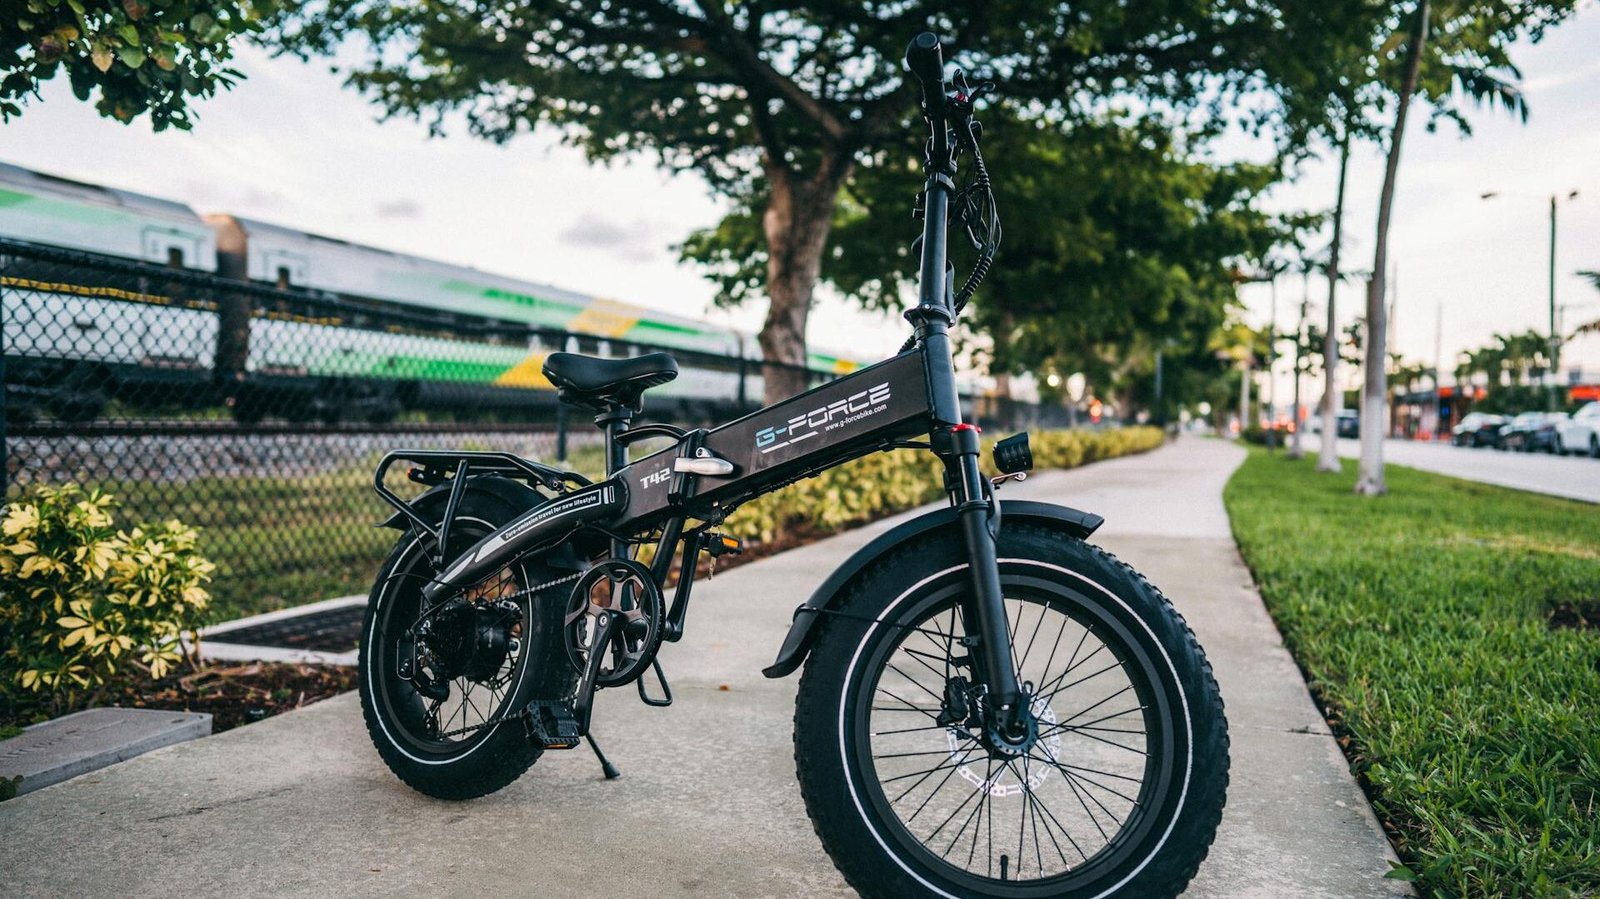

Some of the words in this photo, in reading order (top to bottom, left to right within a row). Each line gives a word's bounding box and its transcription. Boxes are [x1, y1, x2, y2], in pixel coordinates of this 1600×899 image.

[755, 382, 891, 448] G-FORCE
[824, 403, 888, 432] www.g-forcebike.com
[640, 467, 671, 489] T42
[538, 508, 554, 519] travel
[562, 502, 574, 510] new
[573, 495, 597, 506] lifestyle
